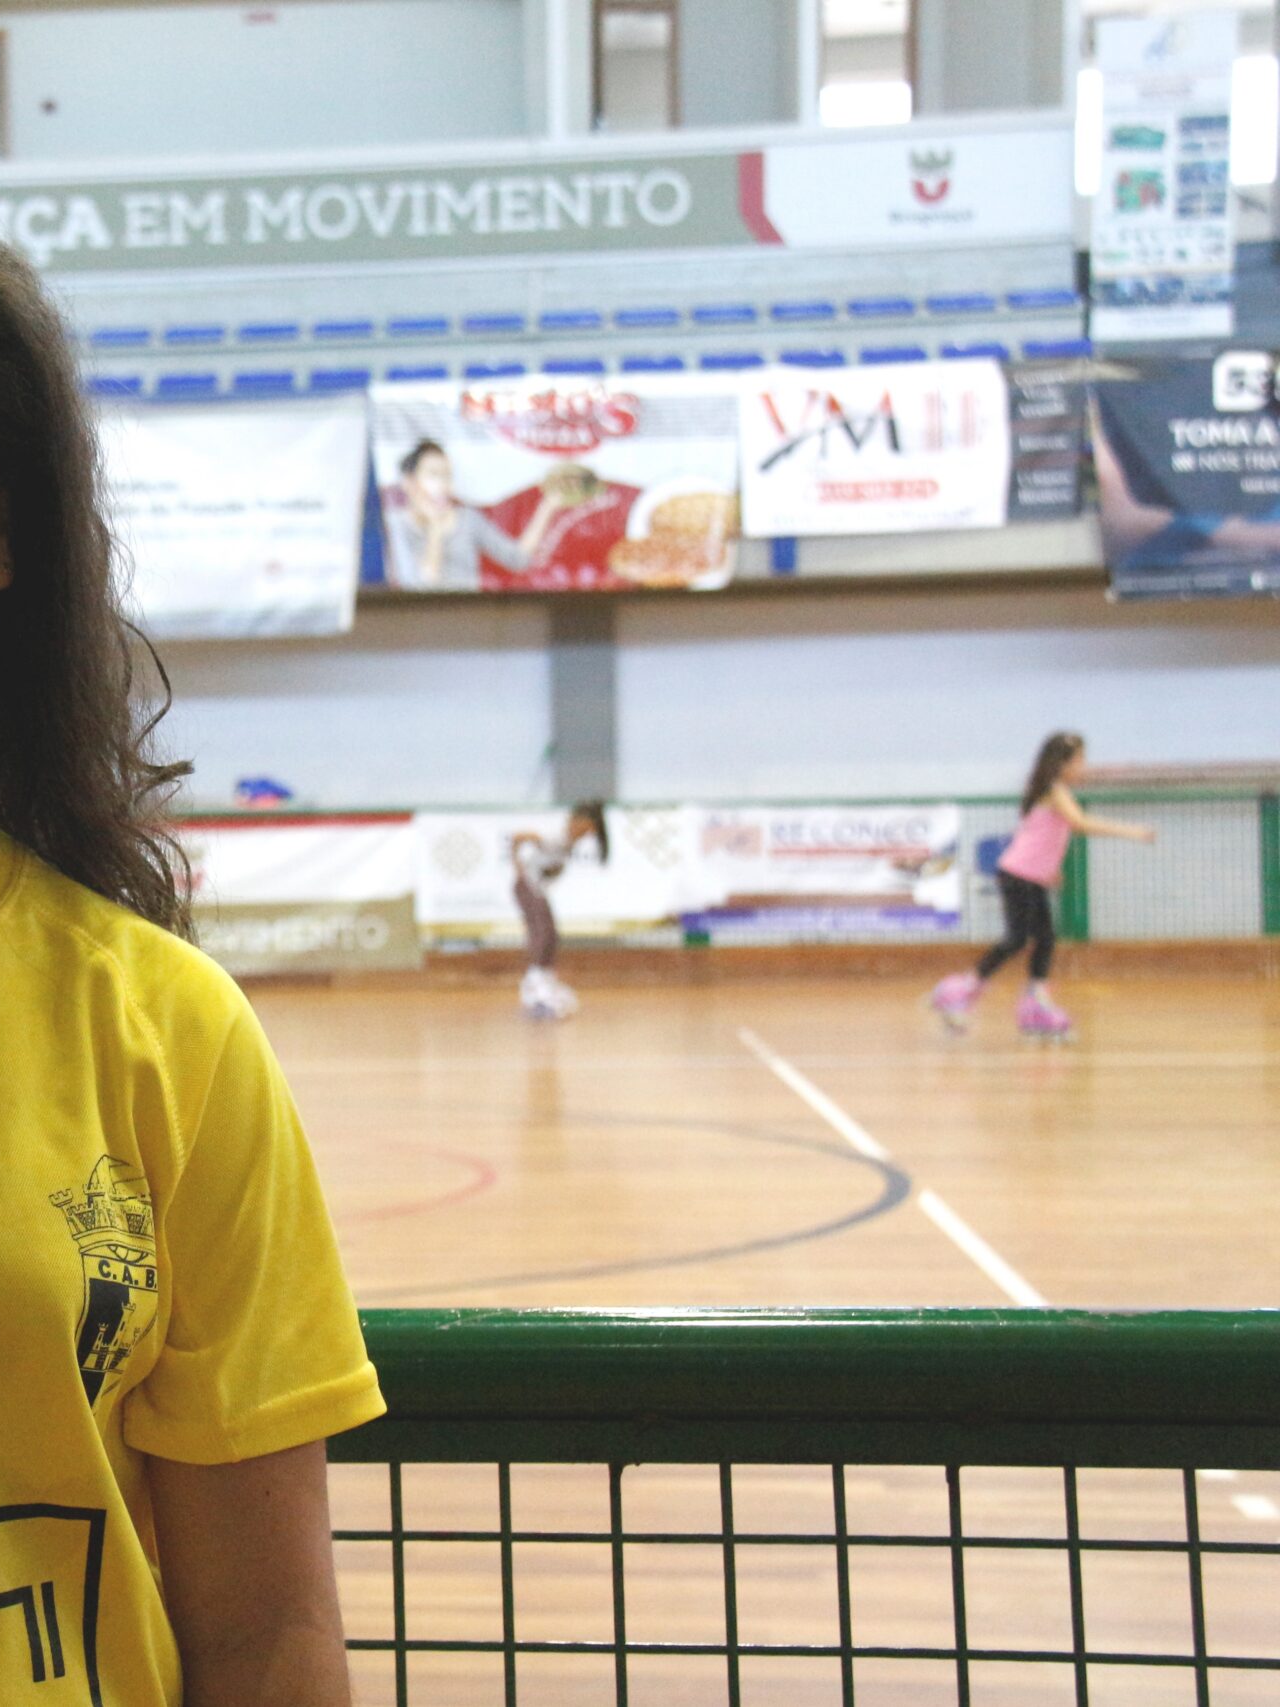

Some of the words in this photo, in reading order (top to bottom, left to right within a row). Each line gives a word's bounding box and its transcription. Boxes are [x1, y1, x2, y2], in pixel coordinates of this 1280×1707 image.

[123, 191, 226, 248] EM
[243, 168, 692, 246] MOVIMENTO
[1169, 417, 1251, 448] TOMA
